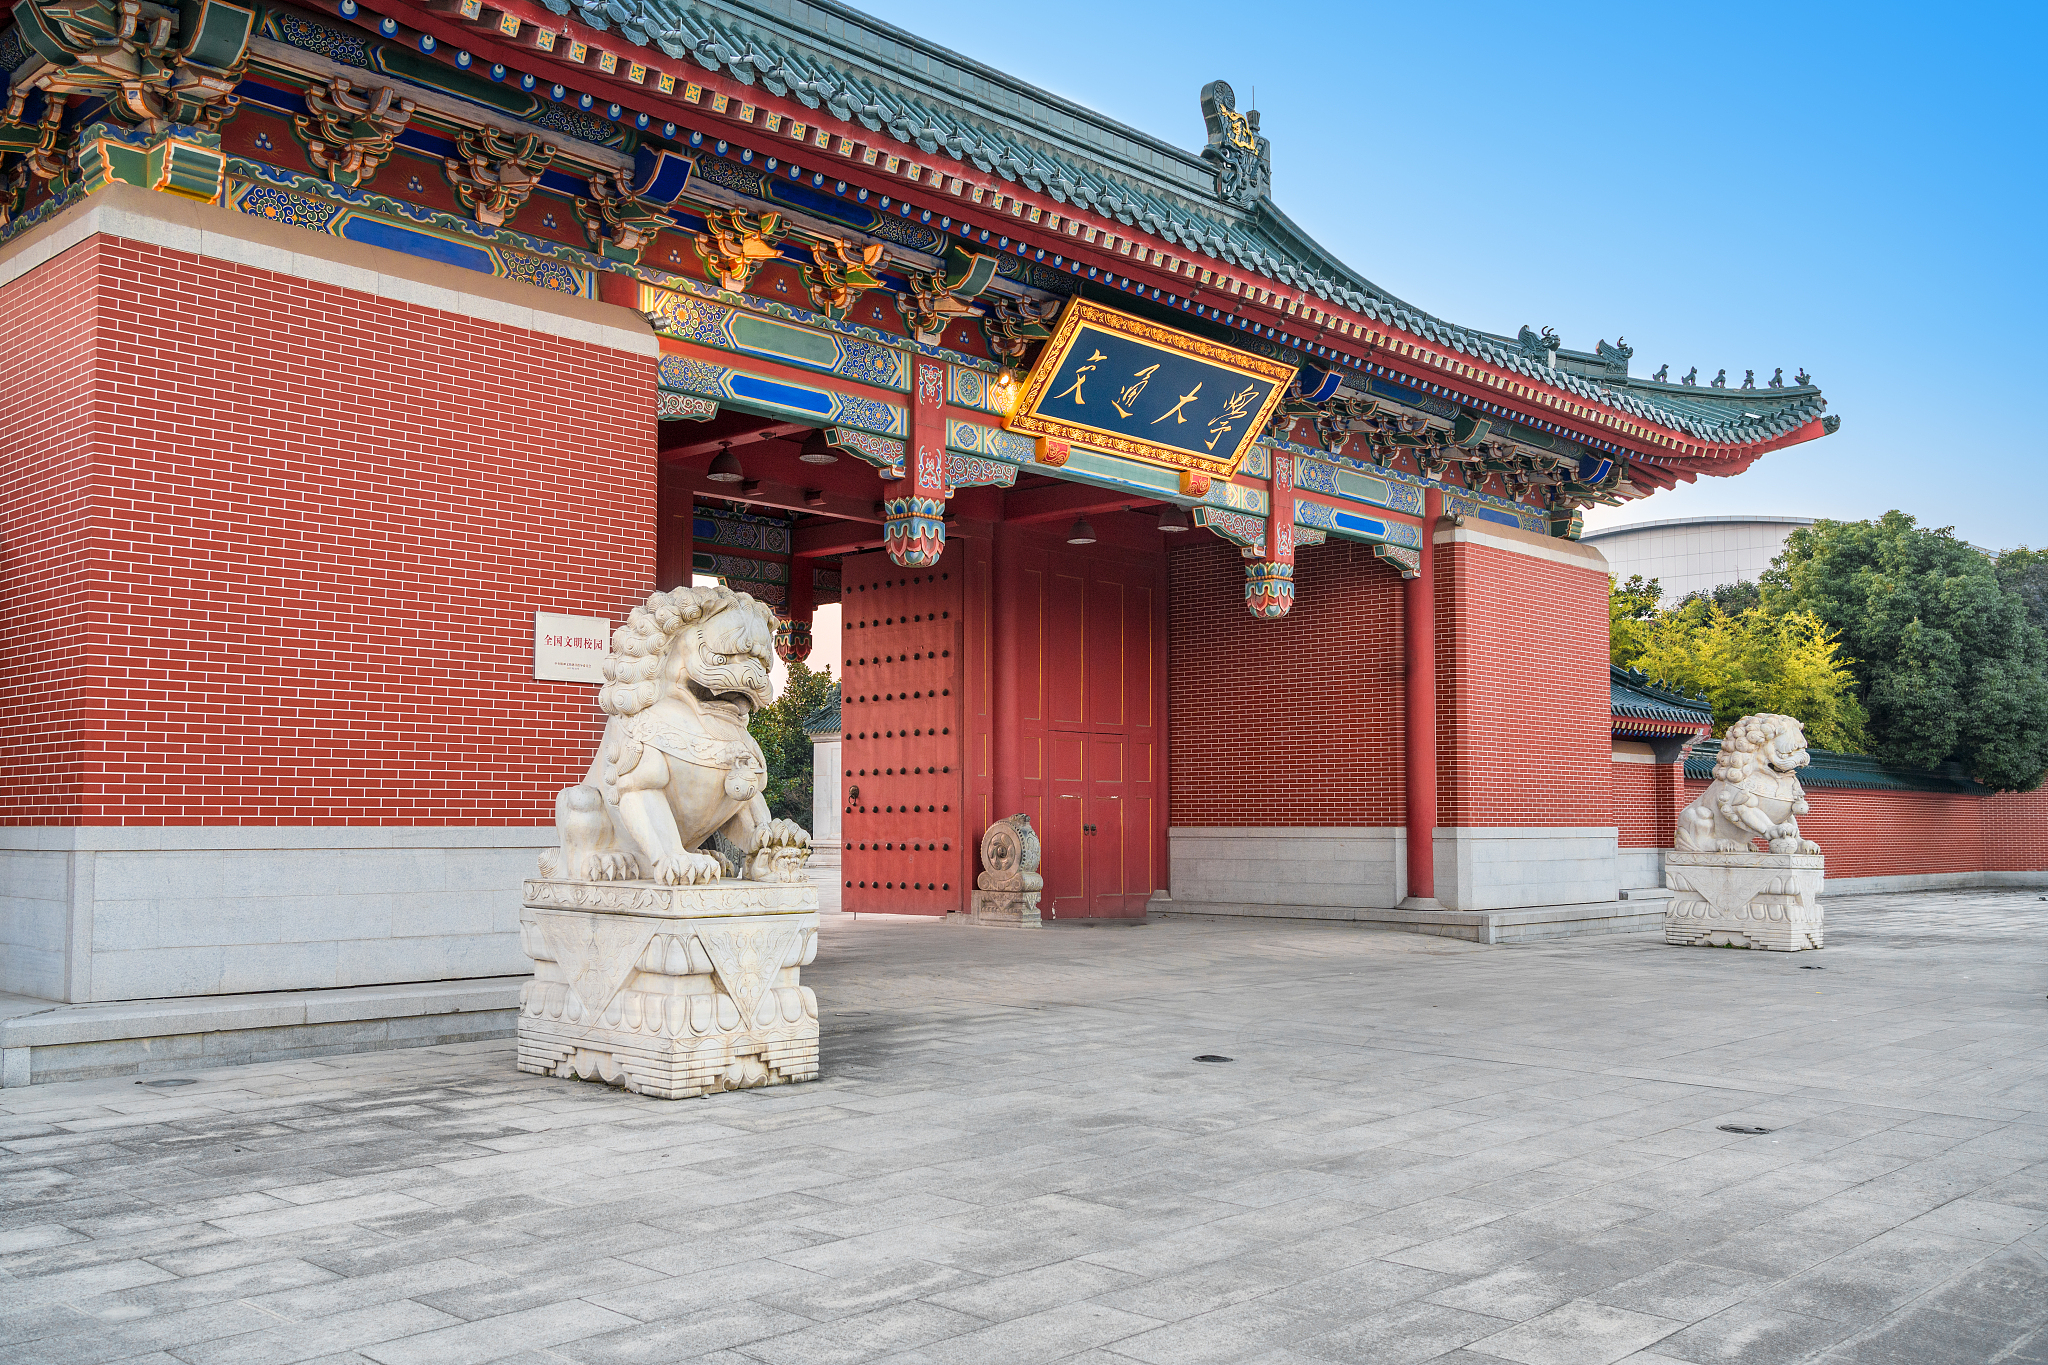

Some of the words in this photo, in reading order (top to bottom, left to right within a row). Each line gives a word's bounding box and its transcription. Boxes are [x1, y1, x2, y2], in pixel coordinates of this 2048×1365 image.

[544, 634, 603, 650] 全国文明校园
